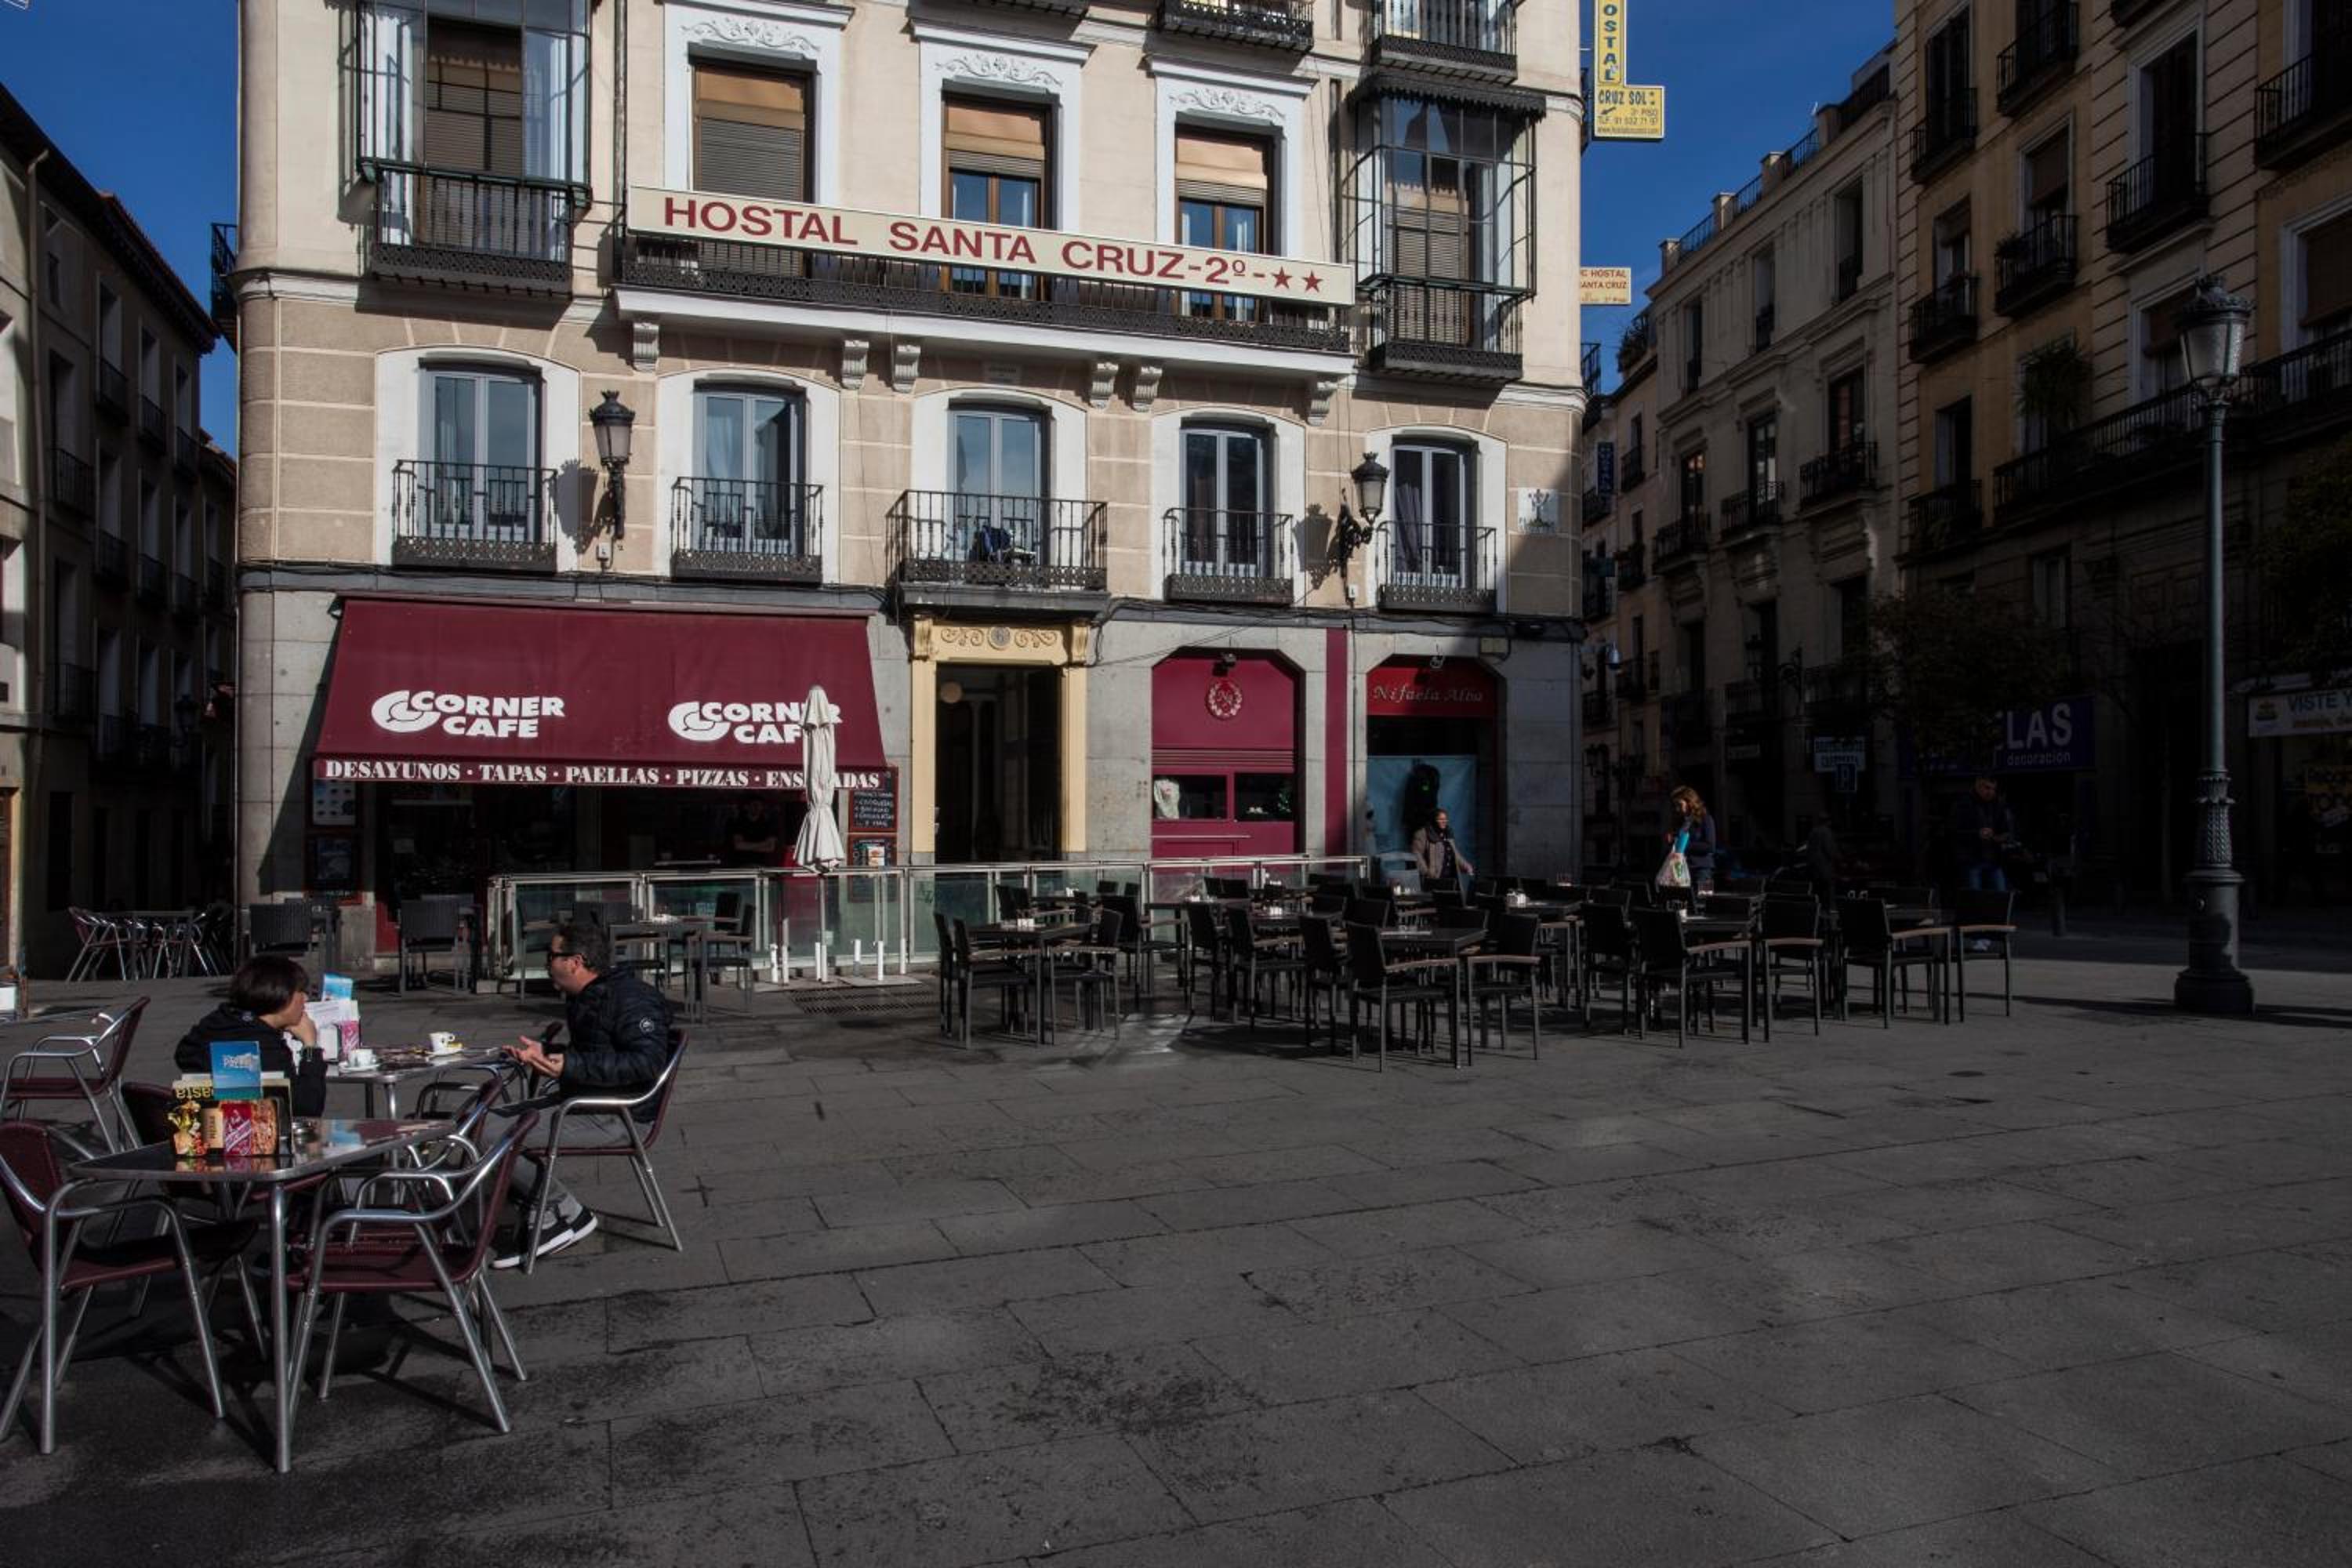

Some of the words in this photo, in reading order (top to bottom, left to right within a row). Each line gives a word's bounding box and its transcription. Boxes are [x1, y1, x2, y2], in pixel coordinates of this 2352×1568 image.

[1598, 89, 1625, 105] CRUZ
[1628, 90, 1647, 105] SOL
[663, 196, 858, 245] HOSTAL
[888, 222, 1037, 265] SANTA
[1592, 269, 1627, 278] HOSTAL
[411, 691, 565, 717] CORNER
[700, 702, 843, 724] CORNR
[442, 716, 539, 738] CAFE
[733, 724, 804, 744] CAF
[325, 760, 460, 780] DESAYUNOS
[480, 764, 546, 782] TAPAS
[565, 765, 659, 785] PAELLAS
[677, 768, 749, 787] PIZZAS
[766, 770, 880, 789] ENSADAS
